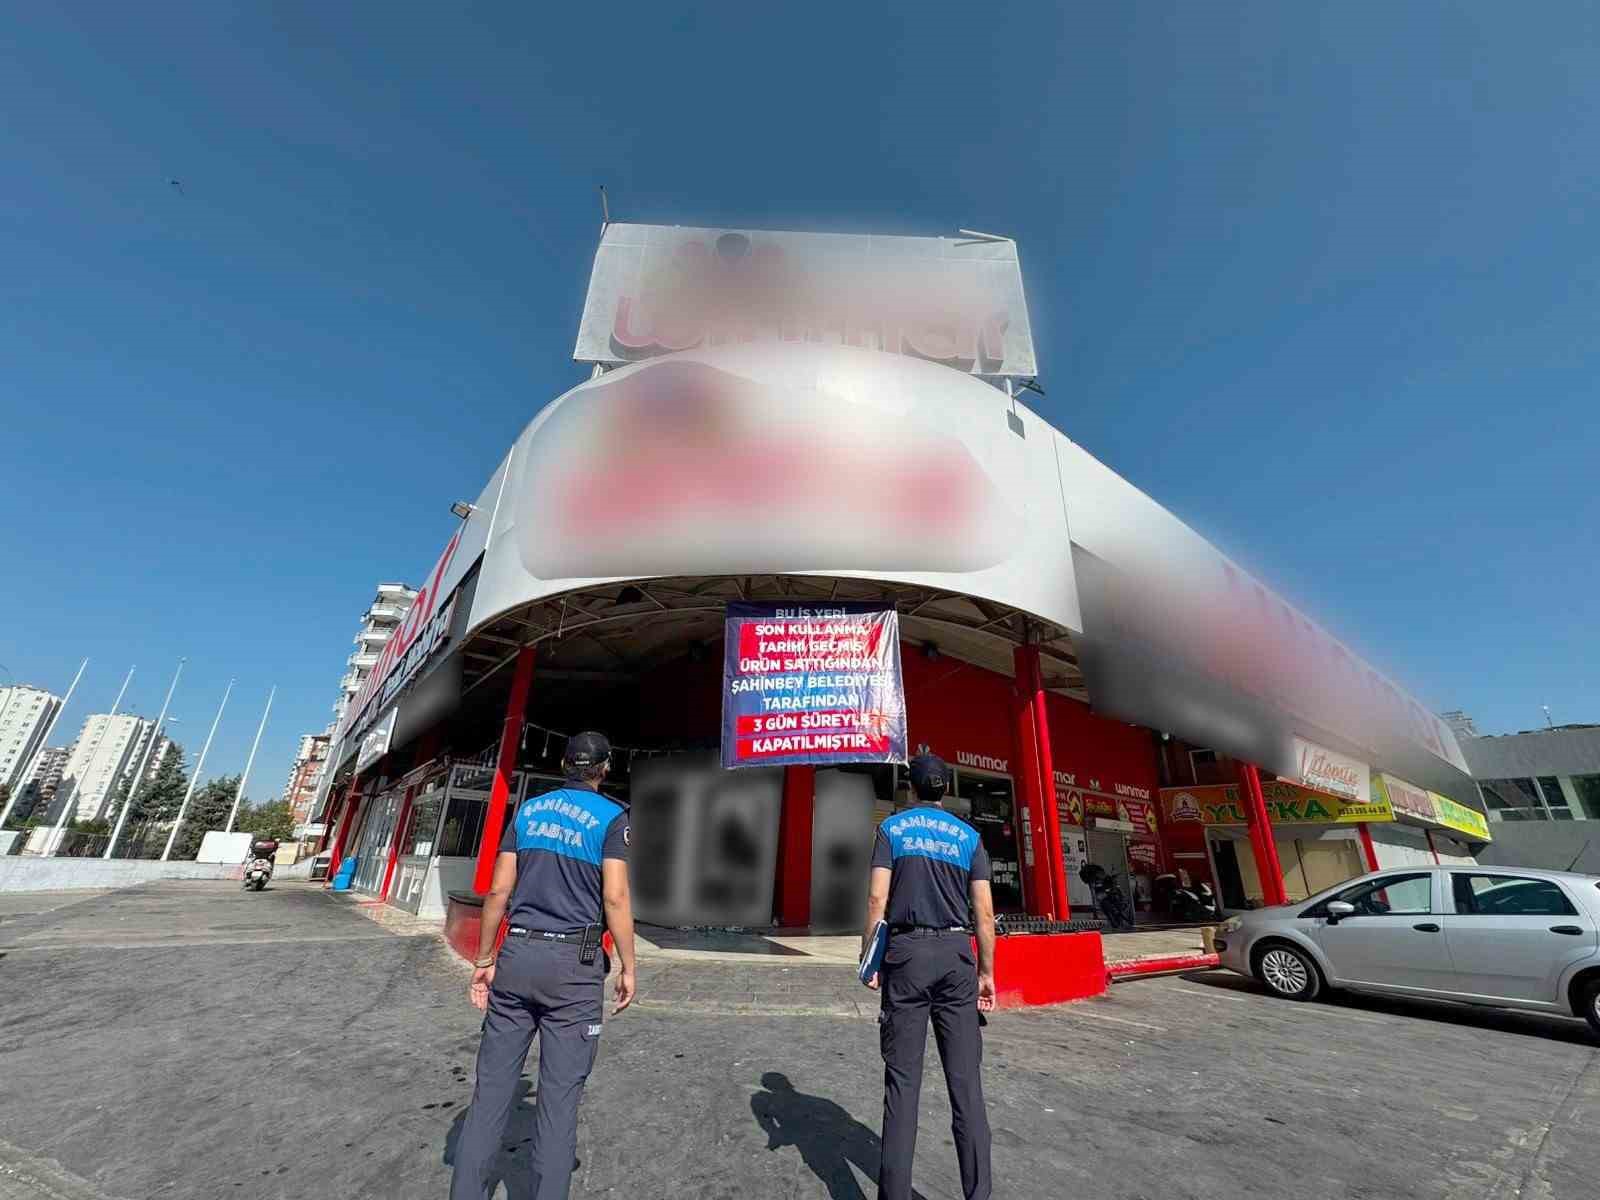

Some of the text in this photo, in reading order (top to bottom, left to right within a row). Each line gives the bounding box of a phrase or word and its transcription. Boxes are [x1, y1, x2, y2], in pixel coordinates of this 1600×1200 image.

[775, 608, 795, 618] BU
[815, 607, 847, 618] YERİ
[755, 623, 868, 636] SON KULLANMA
[740, 657, 780, 672] ÜRÜN
[731, 676, 804, 695] ŞAHİNBEY
[763, 693, 860, 712] TARAFINDAN
[753, 712, 872, 732] 3 GÜN SÜREYLE
[752, 734, 871, 752] KAPATILMIŞTIR.
[956, 751, 1009, 772] winmar
[1114, 783, 1151, 800] winmar
